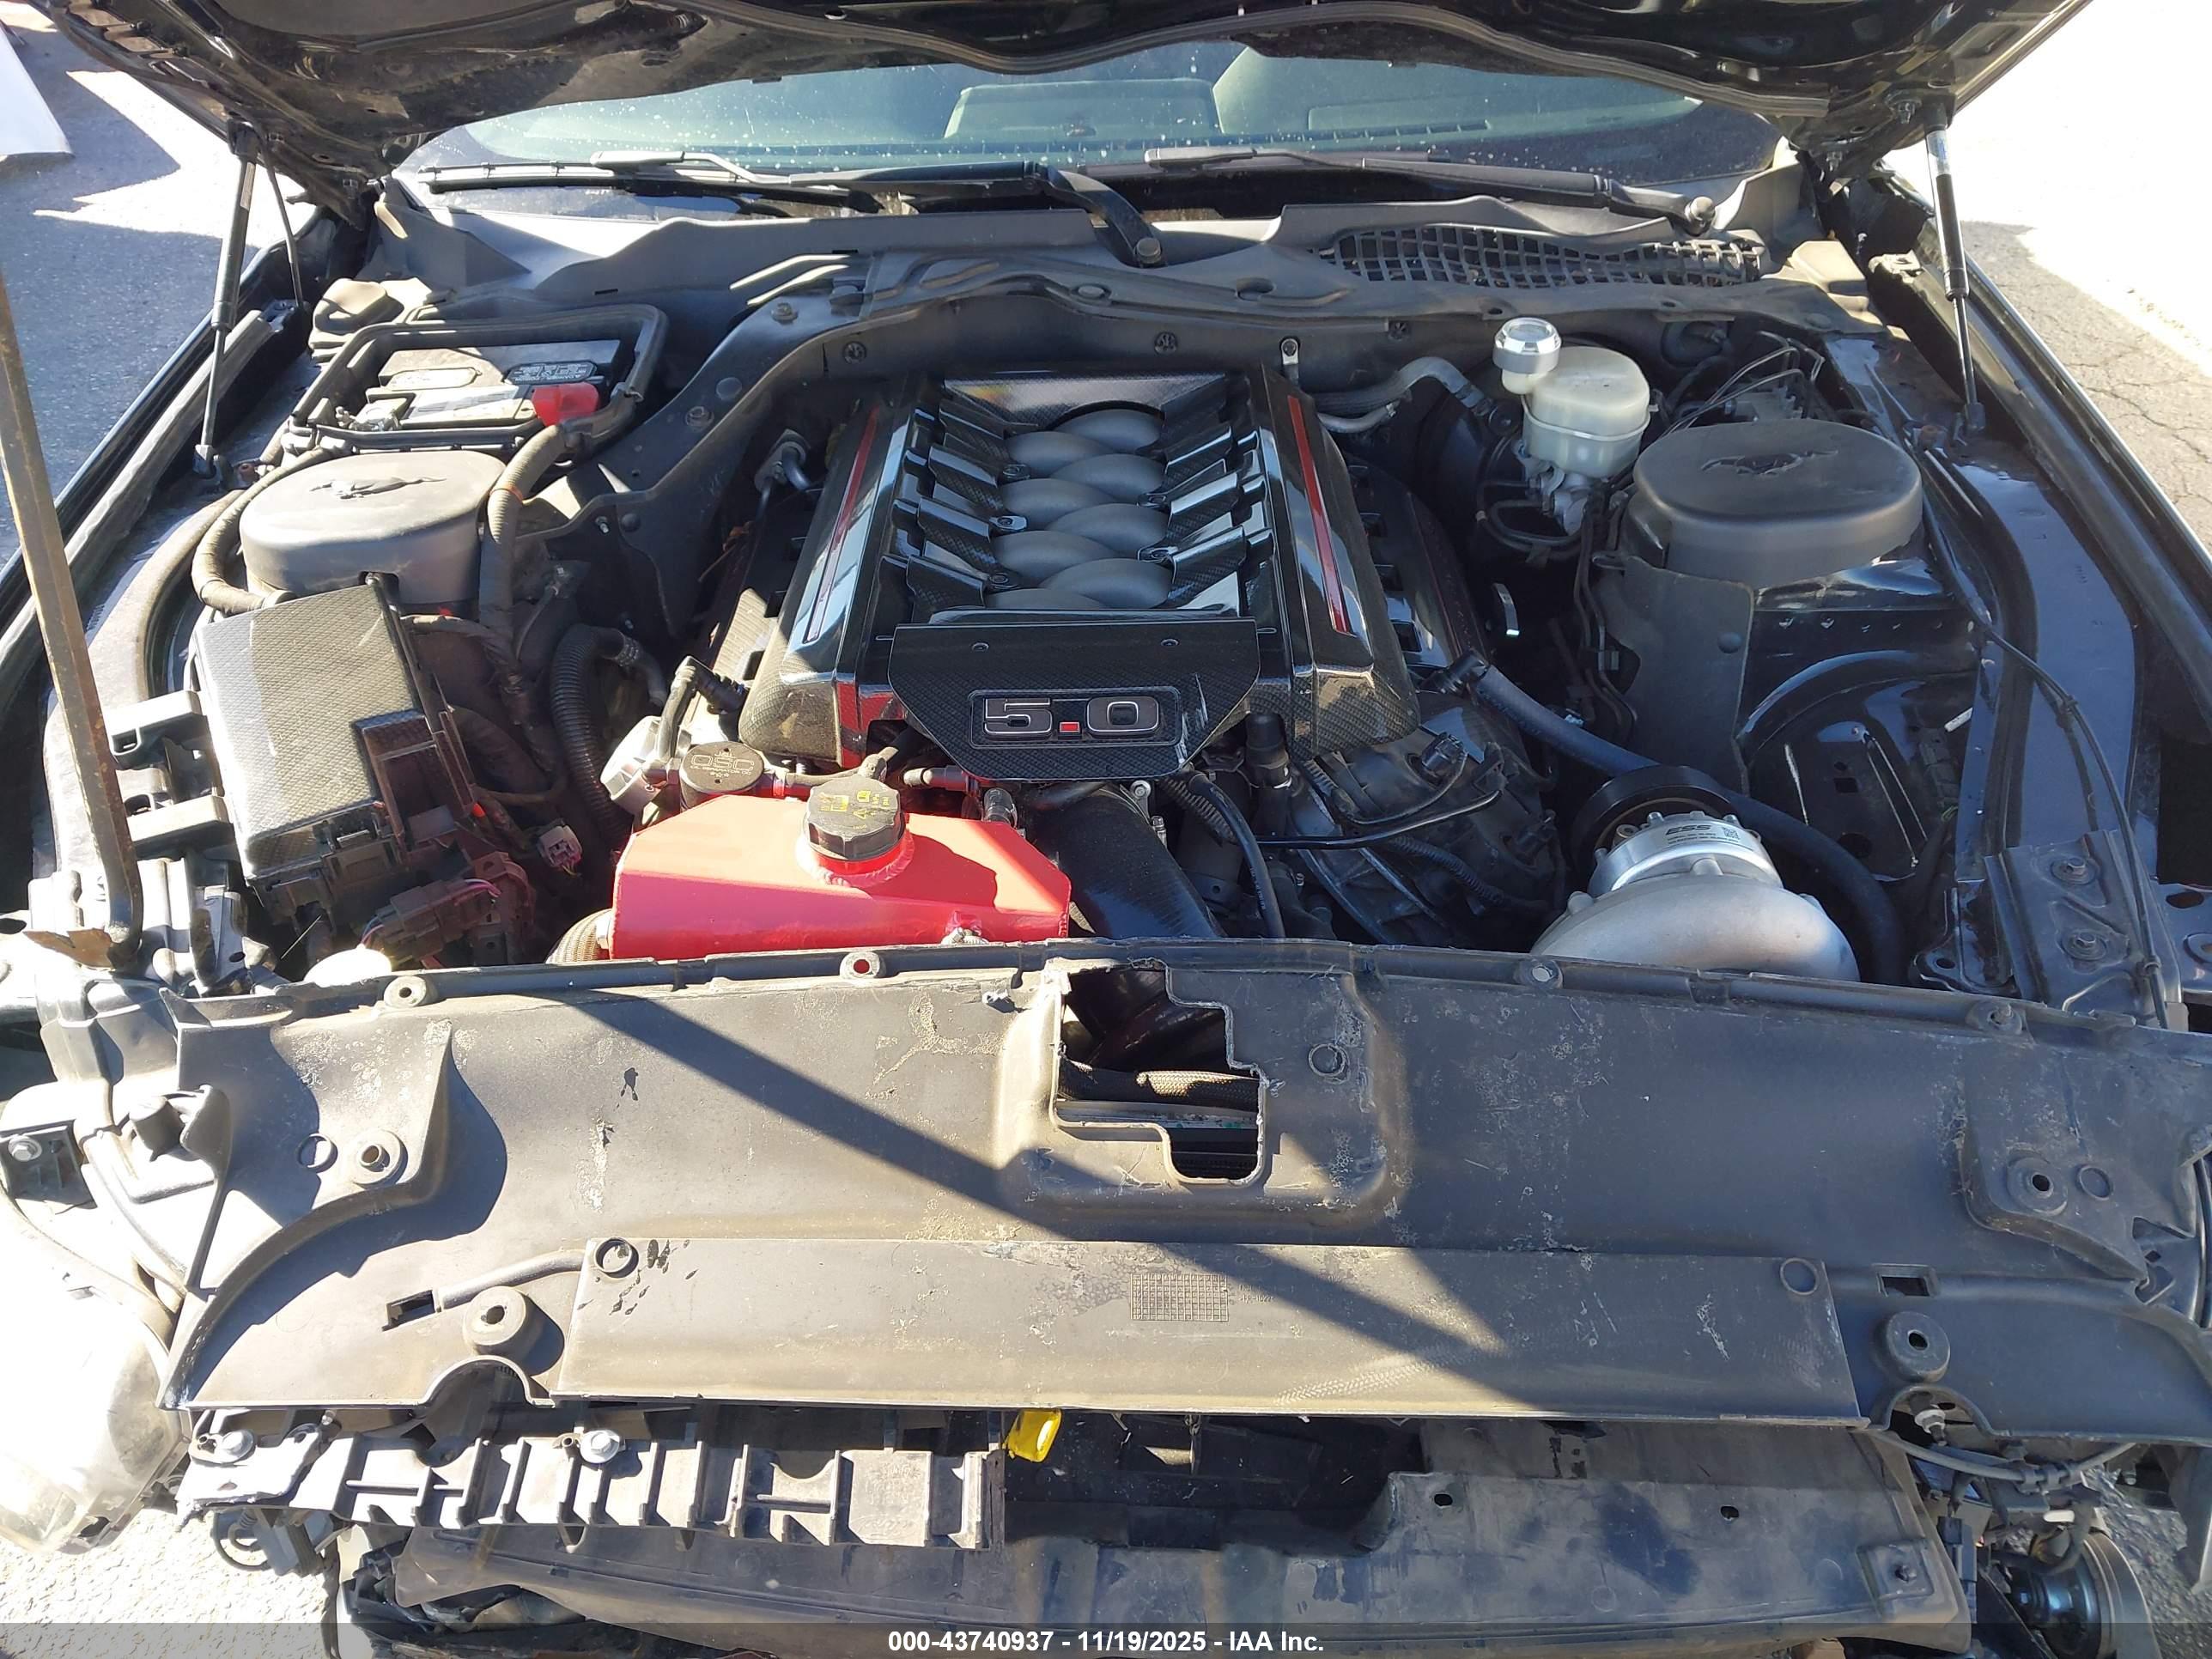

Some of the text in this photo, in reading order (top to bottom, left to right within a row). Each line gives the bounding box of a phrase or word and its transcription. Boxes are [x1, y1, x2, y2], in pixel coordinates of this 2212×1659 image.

[983, 696, 1159, 738] 5.0
[691, 755, 755, 771] OSC
[1666, 825, 1711, 835] ESS
